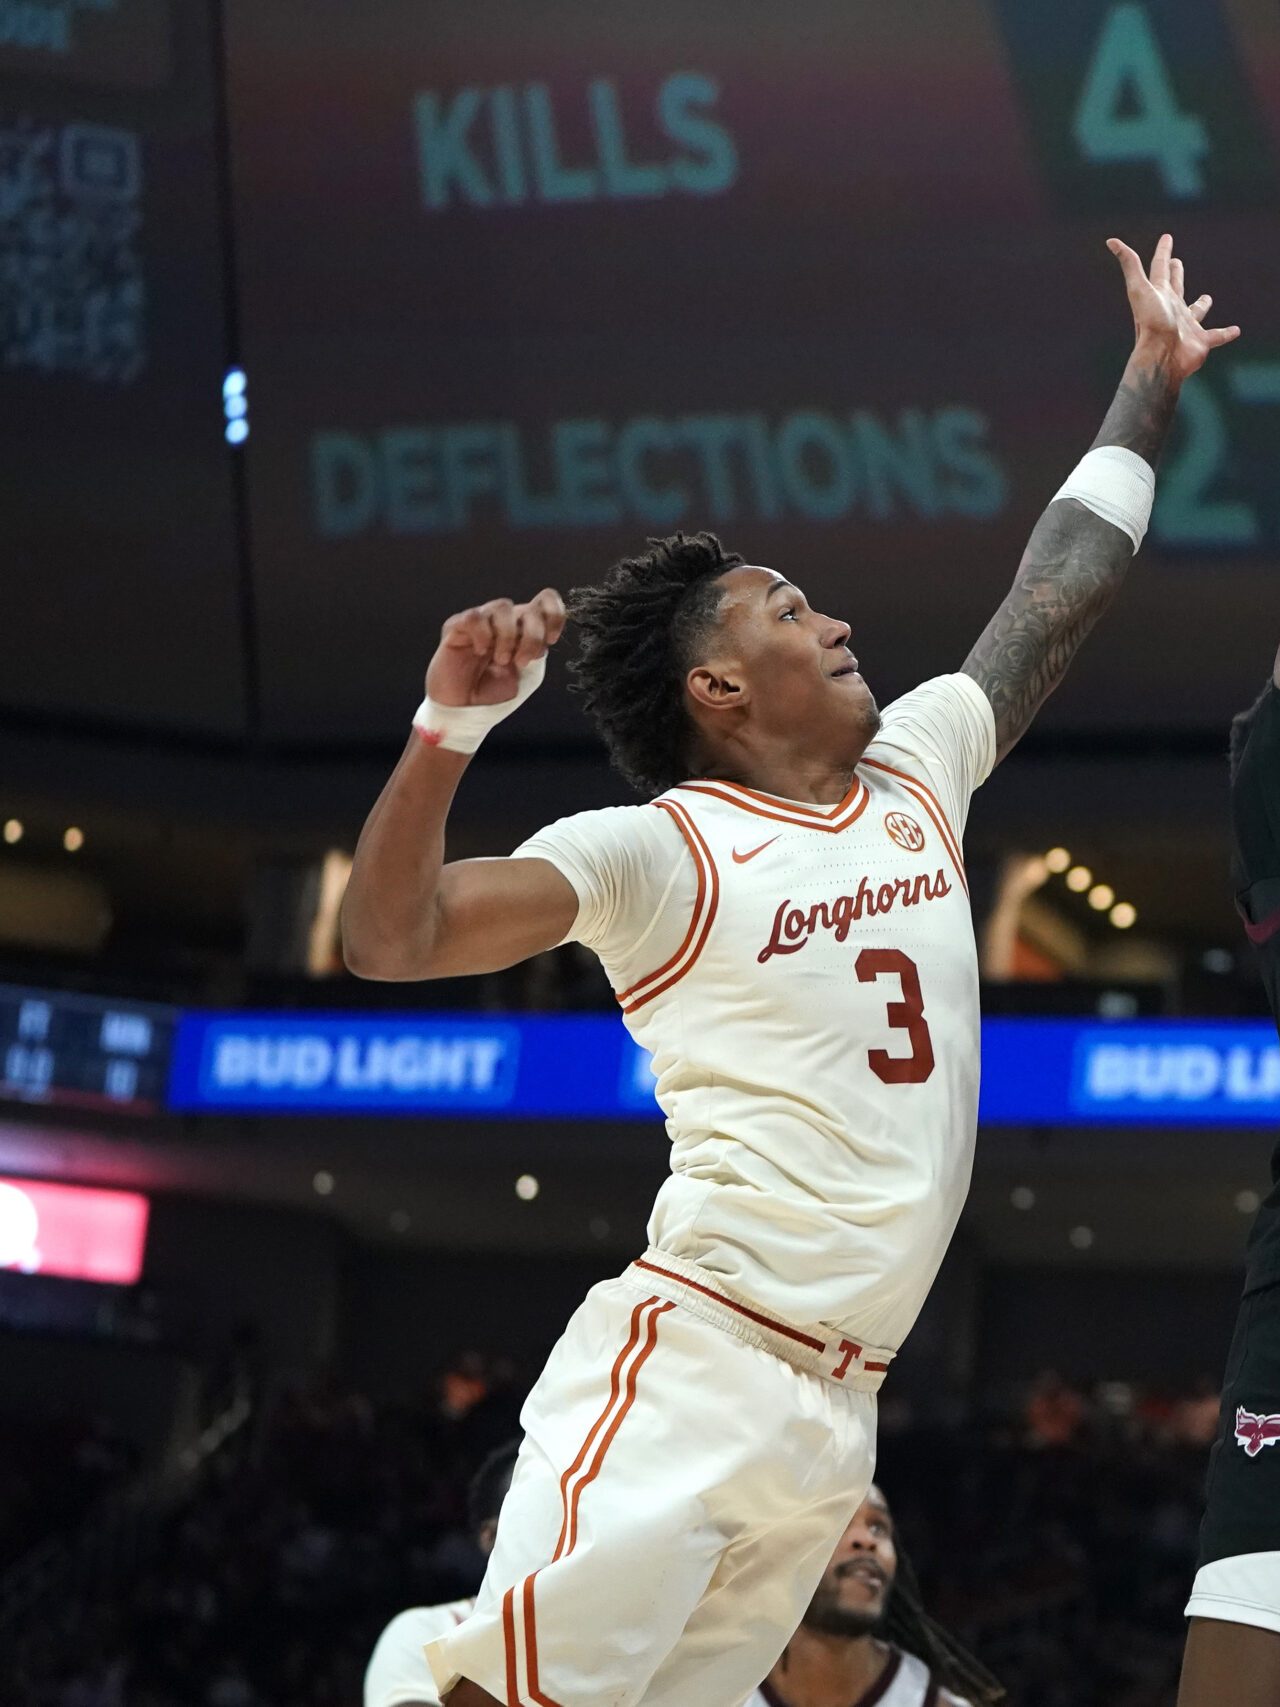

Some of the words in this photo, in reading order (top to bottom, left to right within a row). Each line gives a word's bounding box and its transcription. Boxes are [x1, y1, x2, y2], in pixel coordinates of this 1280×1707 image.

[413, 70, 740, 209] KILLS
[1073, 2, 1211, 196] 4
[311, 408, 1006, 537] DEFLECTIONS
[885, 812, 924, 851] SEC
[757, 869, 952, 963] Longhorns
[855, 949, 935, 1084] 3
[213, 1034, 332, 1090] BUD
[337, 1036, 507, 1094] LIGHT
[1087, 1042, 1222, 1098] BUD
[831, 1338, 863, 1380] T
